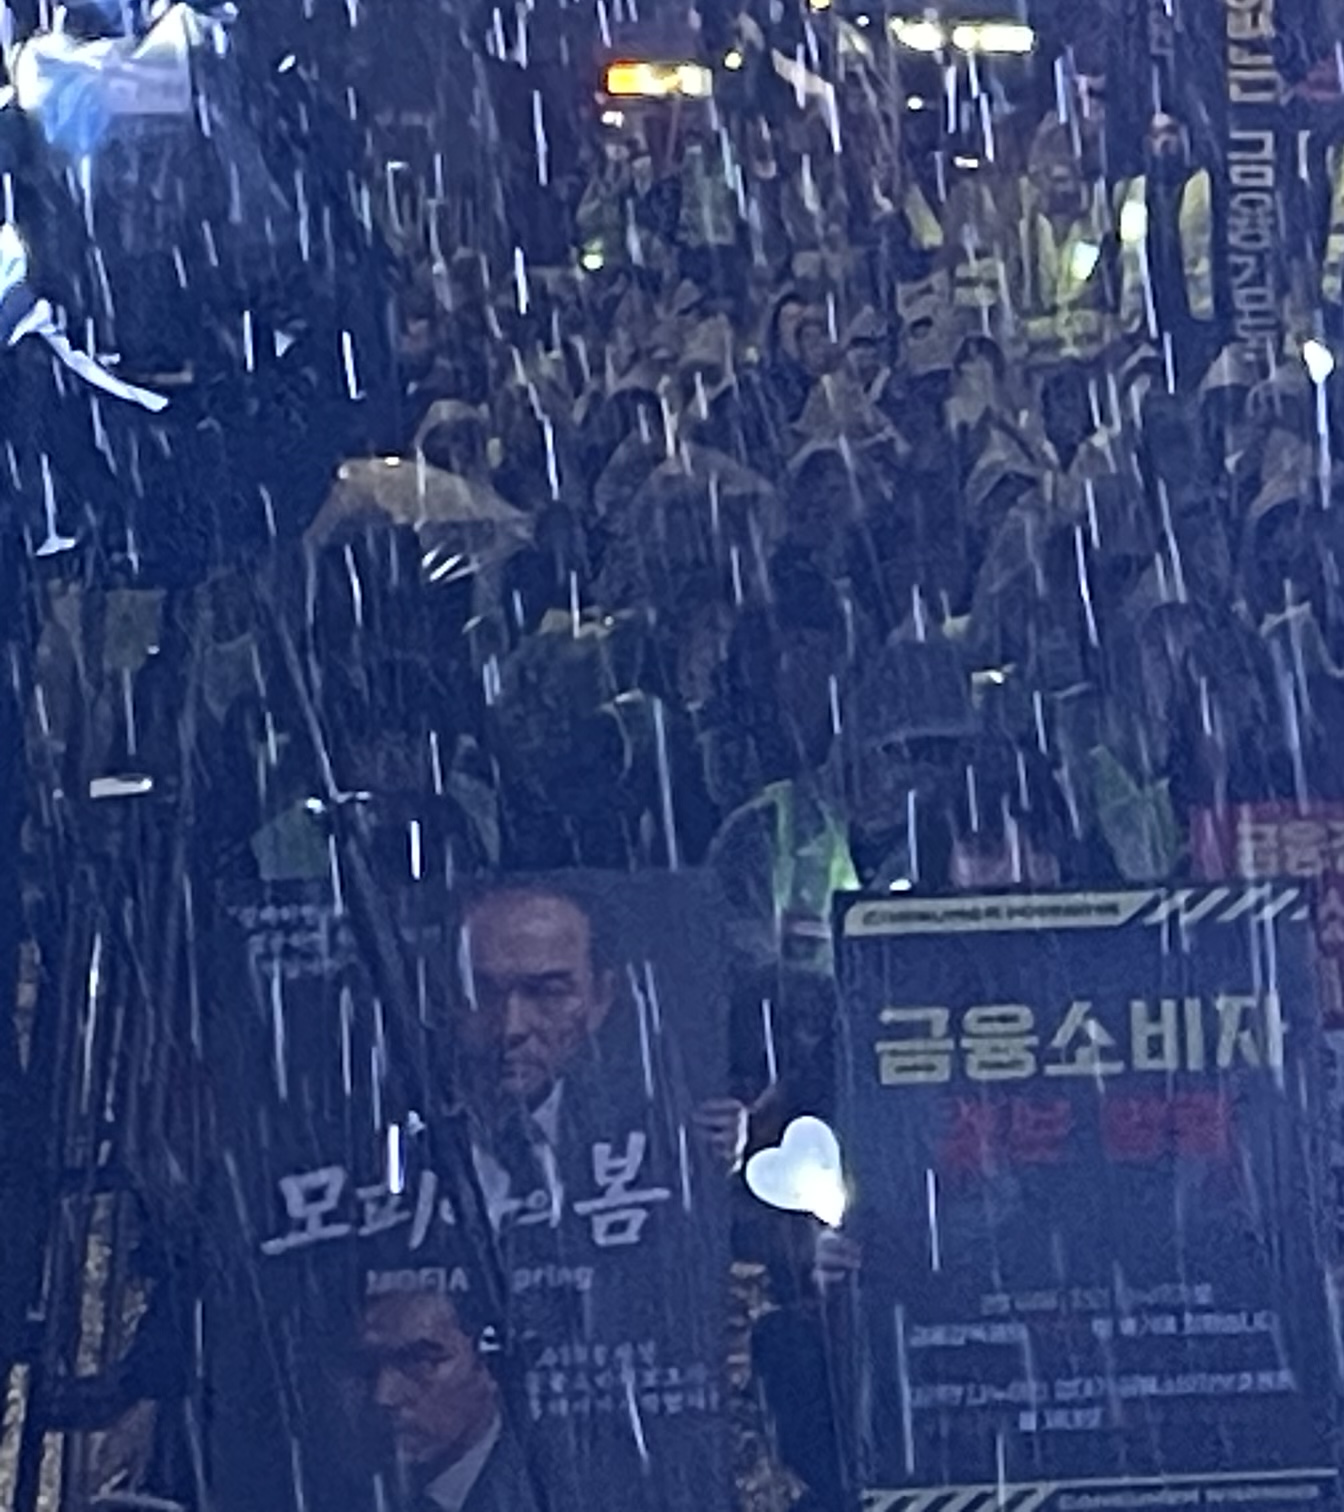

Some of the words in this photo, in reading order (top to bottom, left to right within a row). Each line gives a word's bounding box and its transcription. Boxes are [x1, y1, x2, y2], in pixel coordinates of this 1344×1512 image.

[875, 993, 1288, 1085] 금융소비자
[262, 1166, 562, 1256] 모피의
[573, 1131, 671, 1246] 봄
